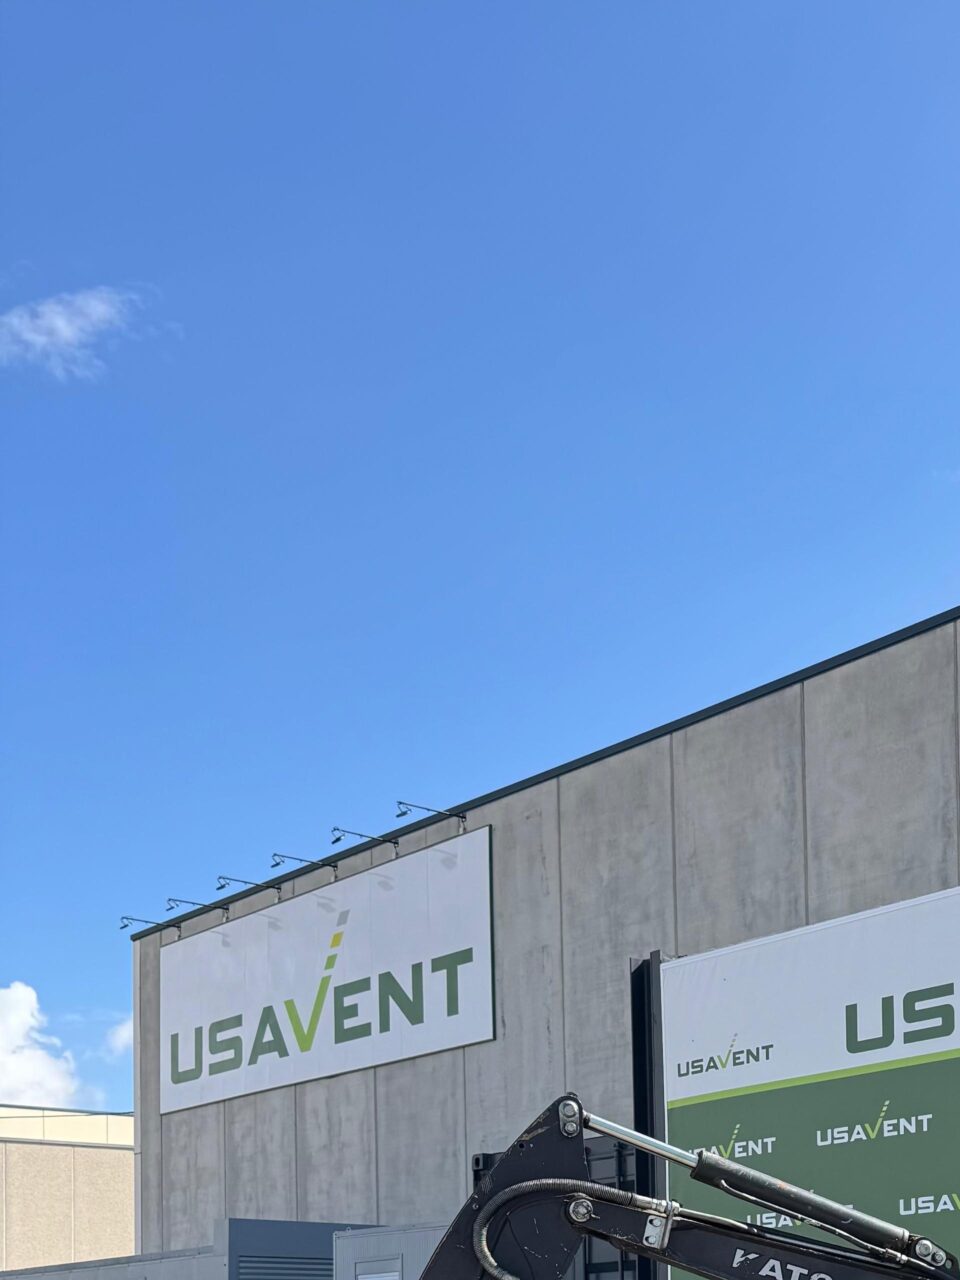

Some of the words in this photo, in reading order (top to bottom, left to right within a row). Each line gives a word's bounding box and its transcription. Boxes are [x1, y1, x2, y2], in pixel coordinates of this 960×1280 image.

[170, 947, 474, 1085] USAVENT
[677, 1044, 774, 1078] USAVENT
[816, 1113, 933, 1146] USAVENT
